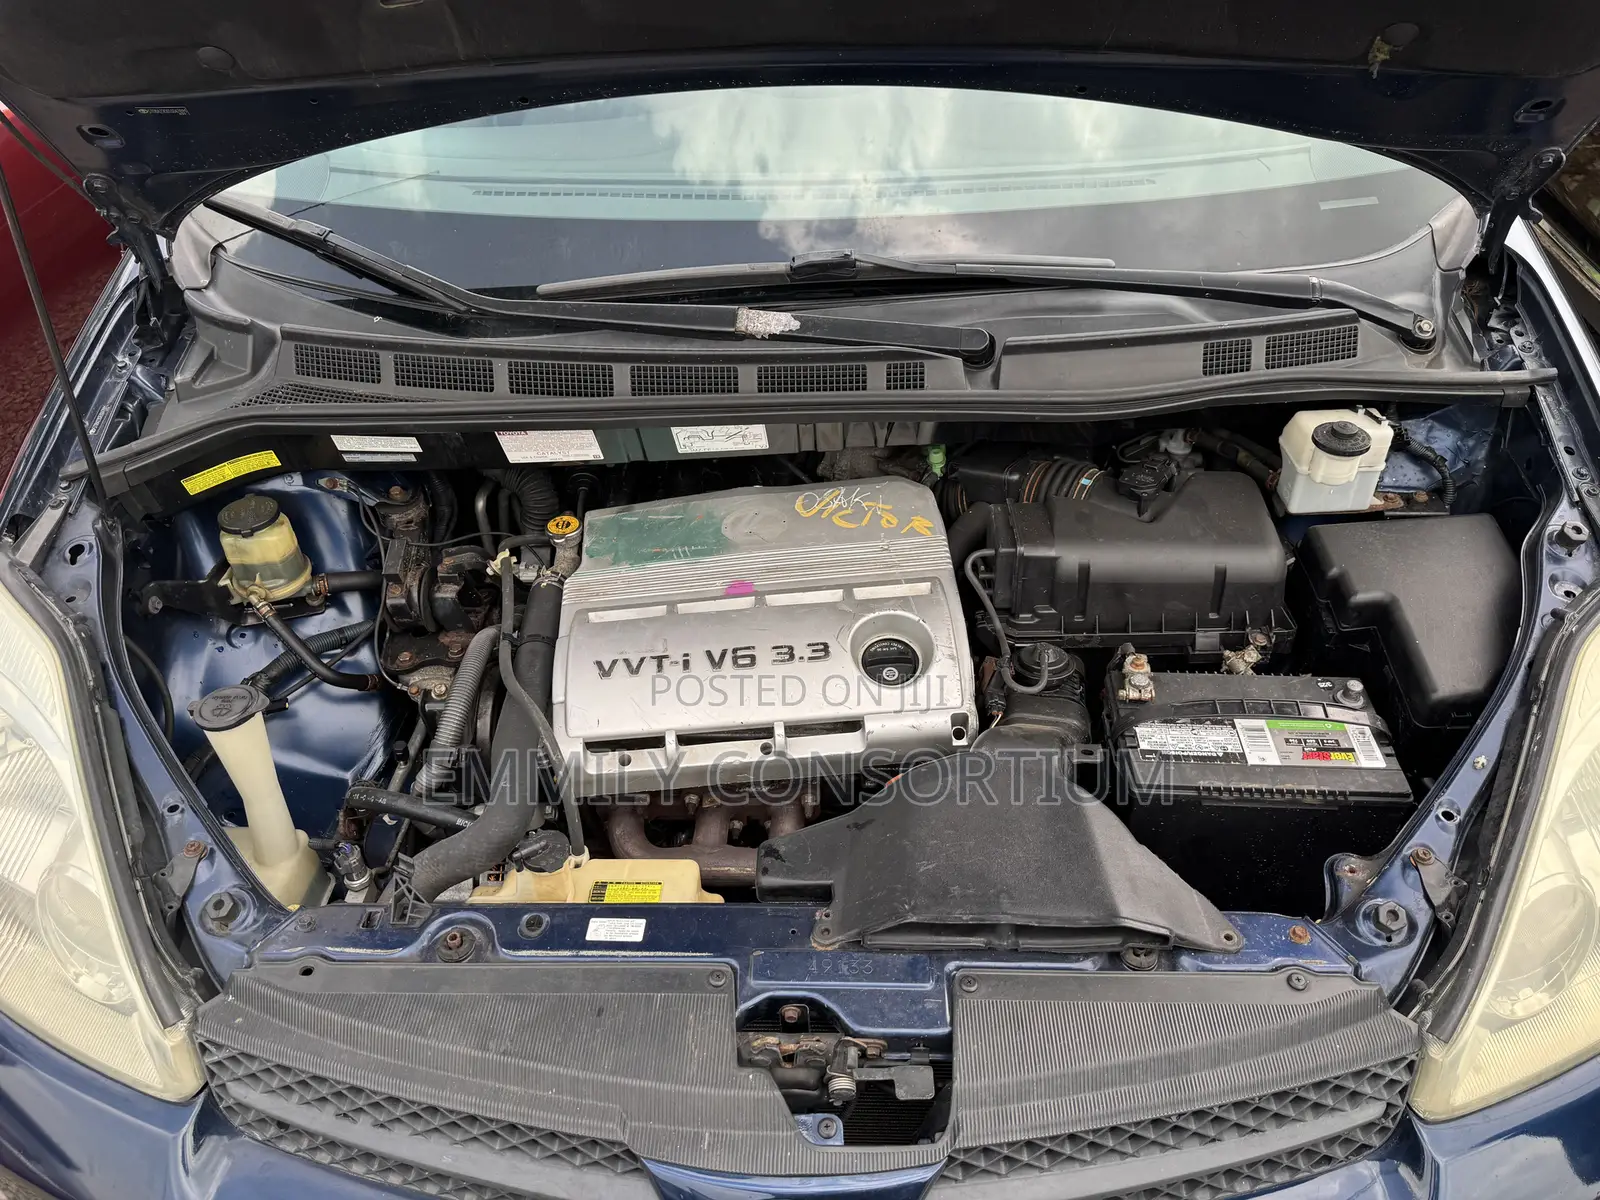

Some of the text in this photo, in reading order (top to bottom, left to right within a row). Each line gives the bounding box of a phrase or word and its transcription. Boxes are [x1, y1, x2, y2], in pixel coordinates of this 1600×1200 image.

[593, 641, 832, 680] VVT-i V6 3.3
[1302, 752, 1355, 762] EverStart
